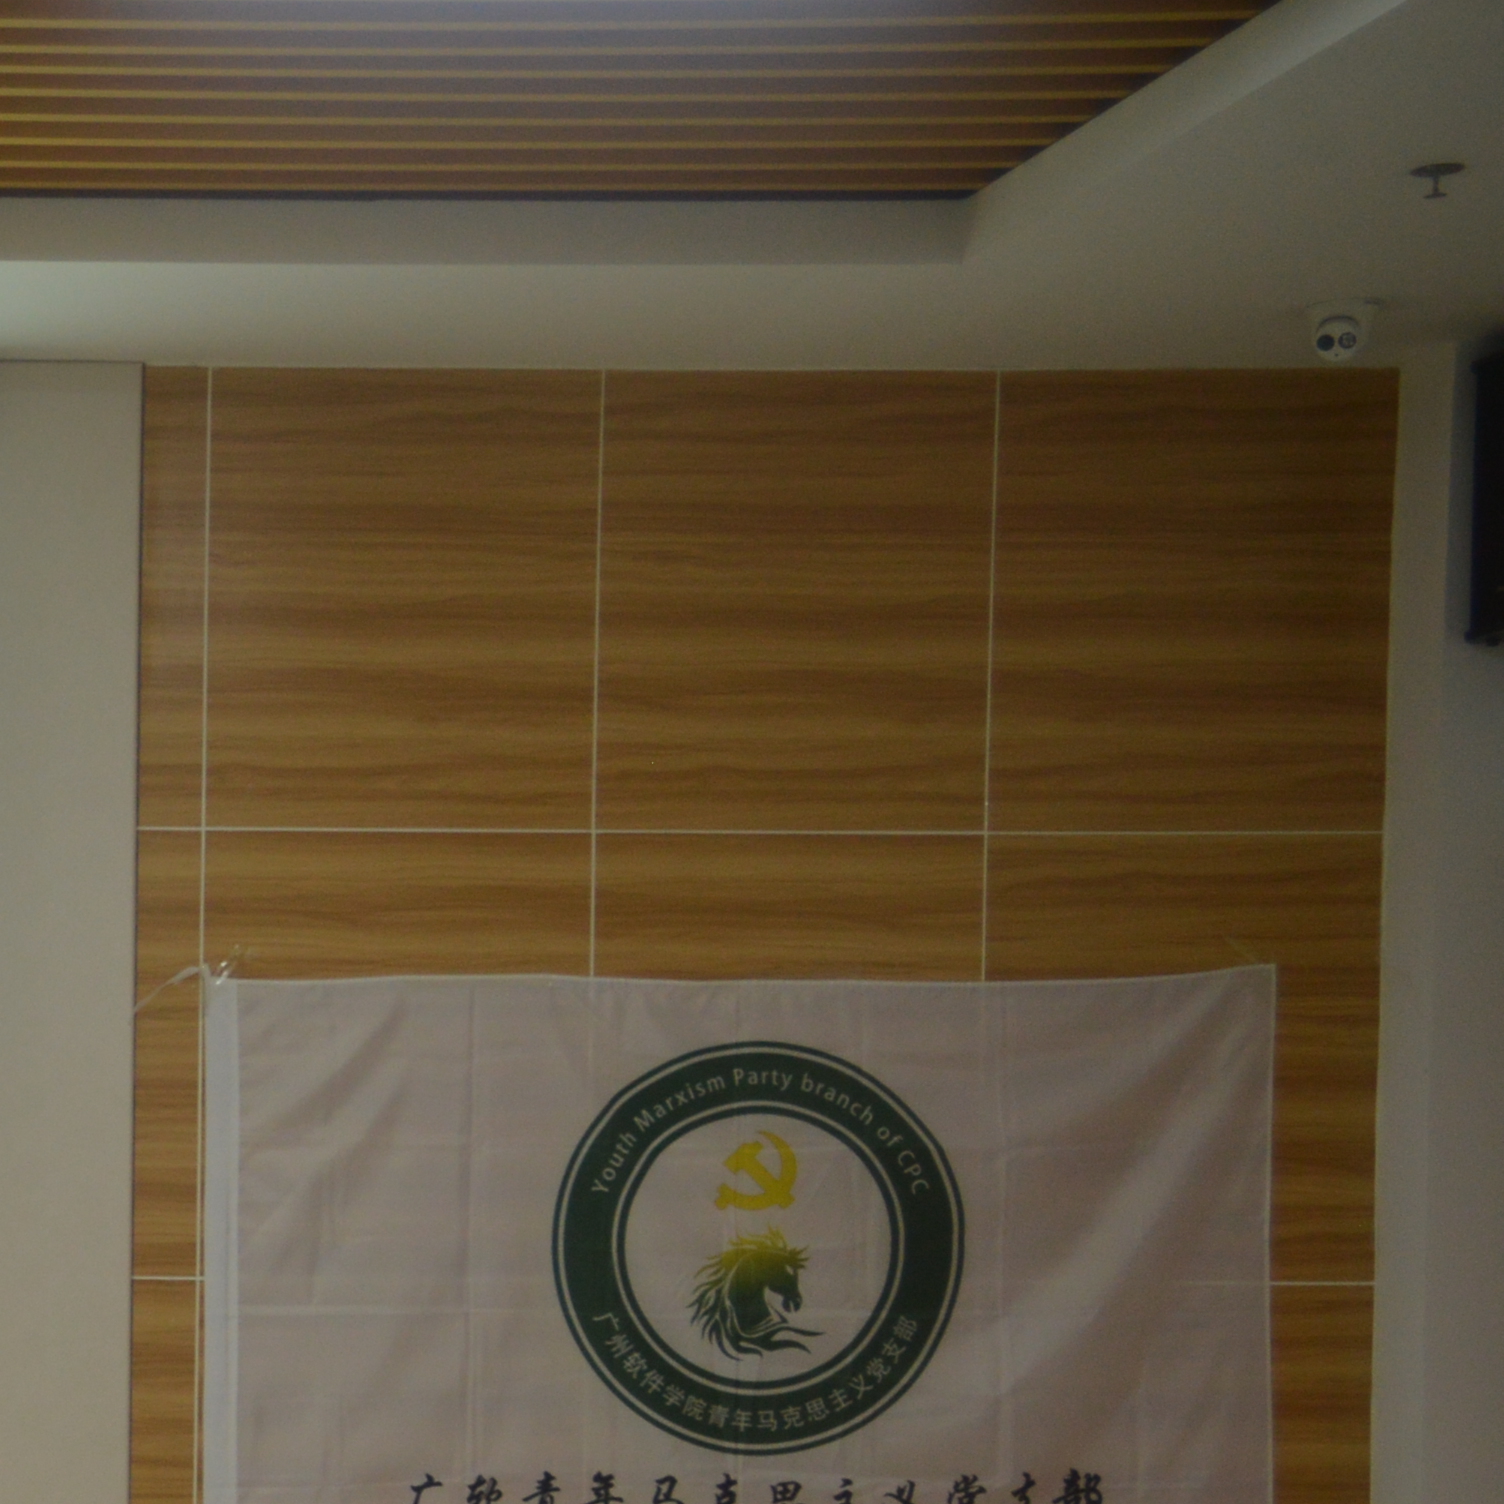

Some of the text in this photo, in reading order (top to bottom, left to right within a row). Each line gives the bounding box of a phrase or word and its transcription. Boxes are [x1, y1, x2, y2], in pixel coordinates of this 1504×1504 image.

[591, 1068, 930, 1196] Youth Marxism Party branch of CPC
[592, 1312, 919, 1433] 广州软件学院青年马克思主义党支部
